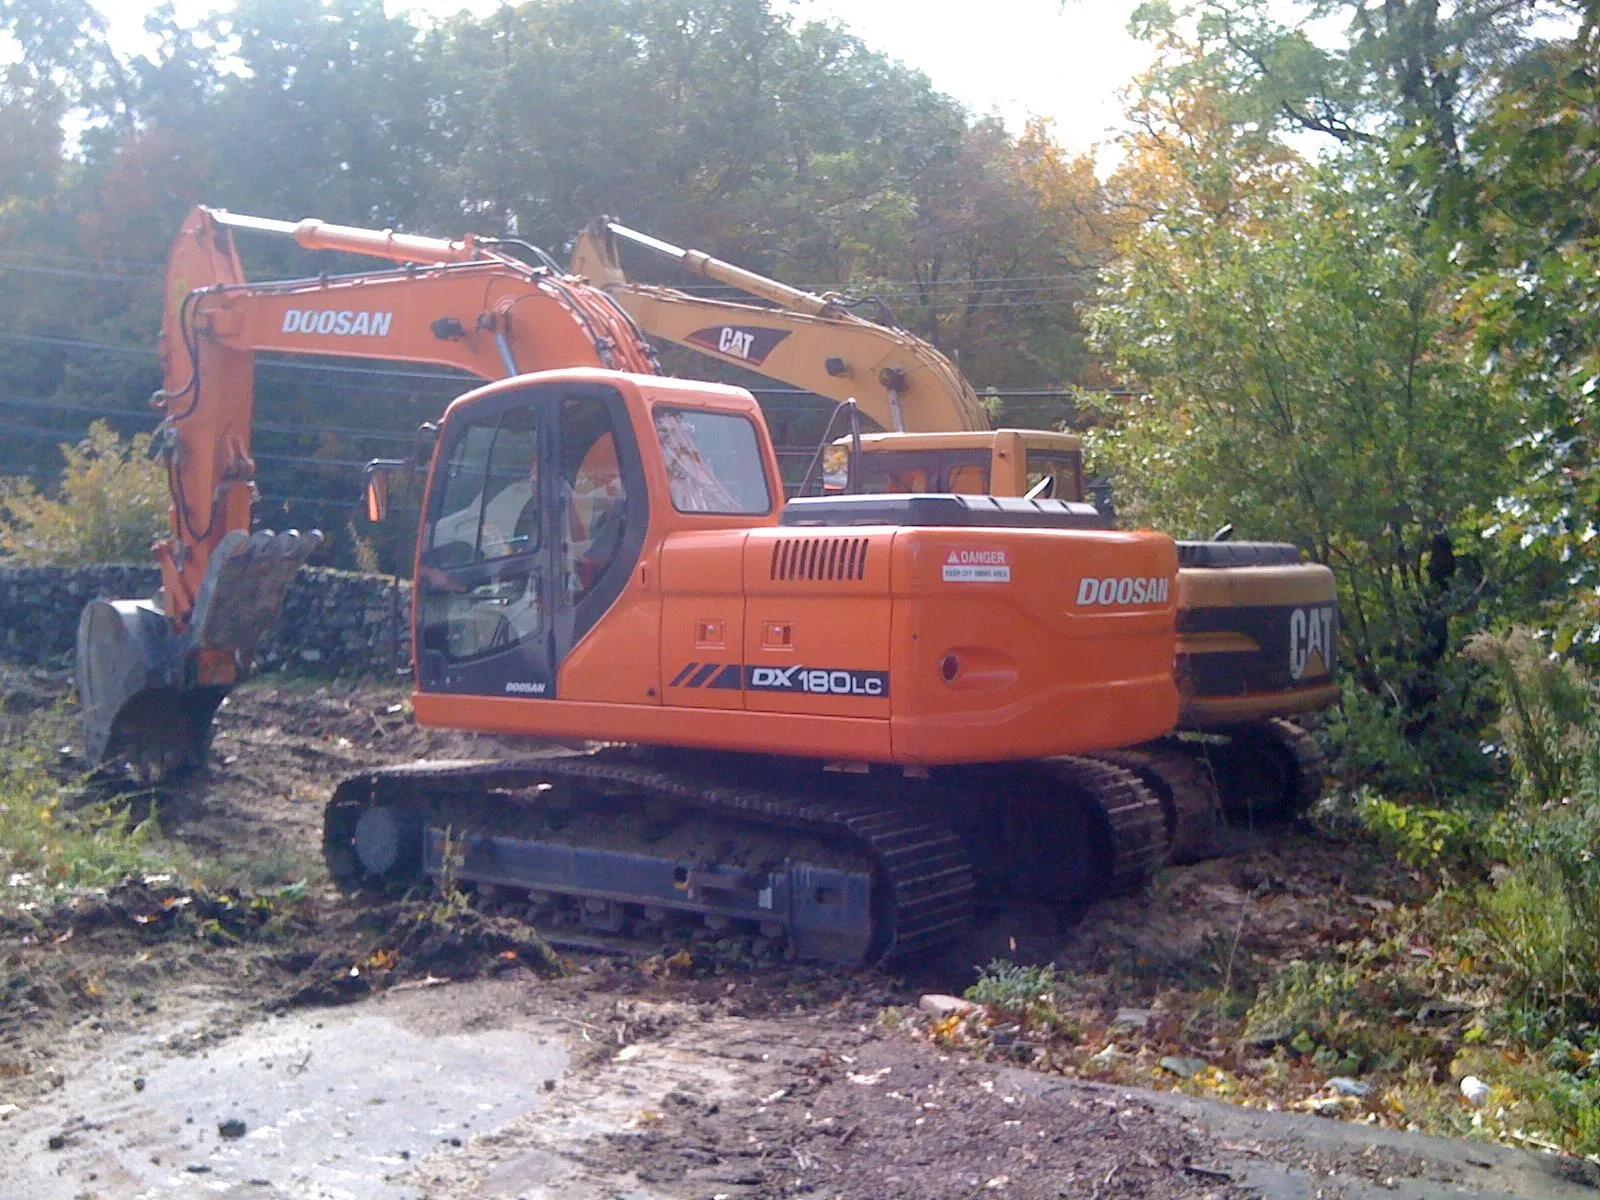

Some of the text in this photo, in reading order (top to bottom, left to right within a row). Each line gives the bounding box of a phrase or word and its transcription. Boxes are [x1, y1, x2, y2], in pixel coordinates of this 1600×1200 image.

[282, 309, 393, 336] DOOSAN
[719, 327, 755, 359] CAT
[960, 551, 1006, 564] DANGER
[1076, 577, 1169, 606] DOOSAN
[1290, 607, 1333, 679] CAT
[505, 682, 546, 693] DOOSAN
